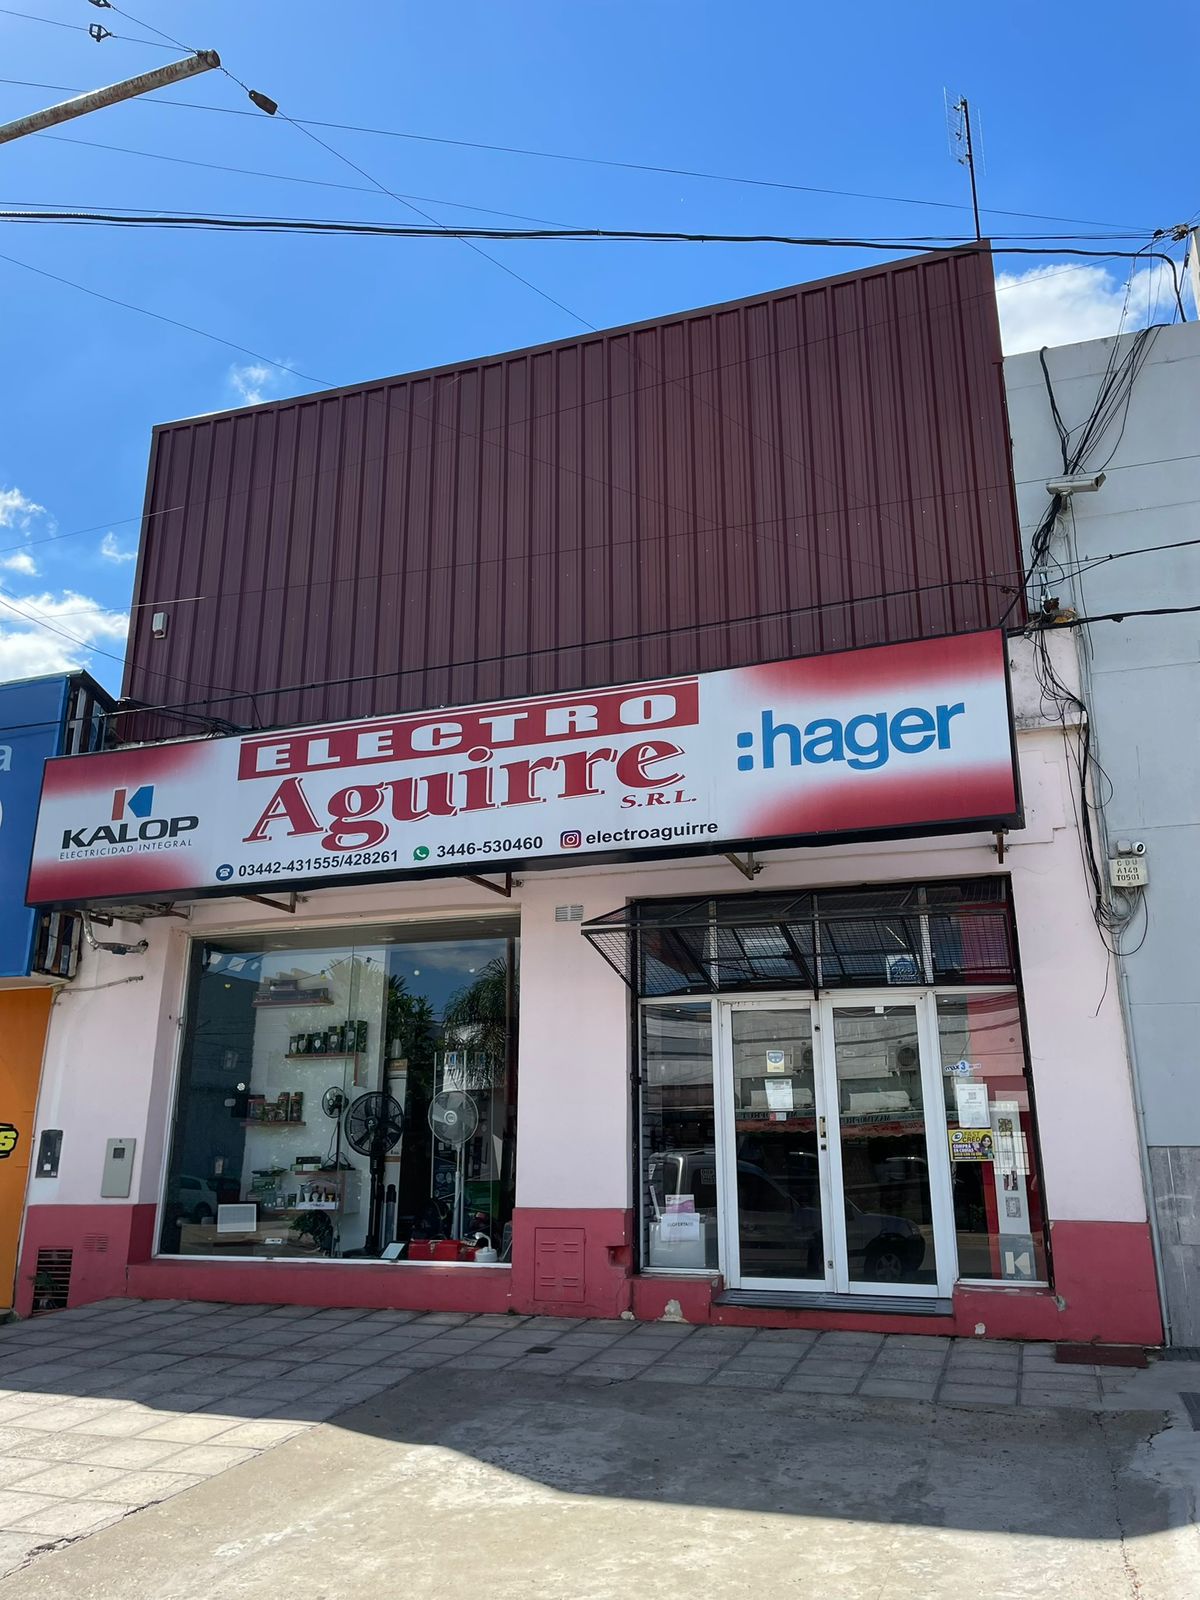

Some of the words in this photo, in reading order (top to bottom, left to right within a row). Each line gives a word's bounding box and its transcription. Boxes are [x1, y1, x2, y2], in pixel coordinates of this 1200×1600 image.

[255, 694, 677, 772] ELECTRO
[242, 739, 686, 852] Aguirre
[620, 789, 698, 809] S.R.L.
[59, 844, 134, 860] ELECTRICIDAD
[138, 839, 193, 852] INTEGRAL
[61, 815, 200, 850] KALOP
[238, 850, 398, 877] 03442-431555/428261
[436, 835, 543, 859] 3446-530460
[585, 822, 719, 846] electroaguirre
